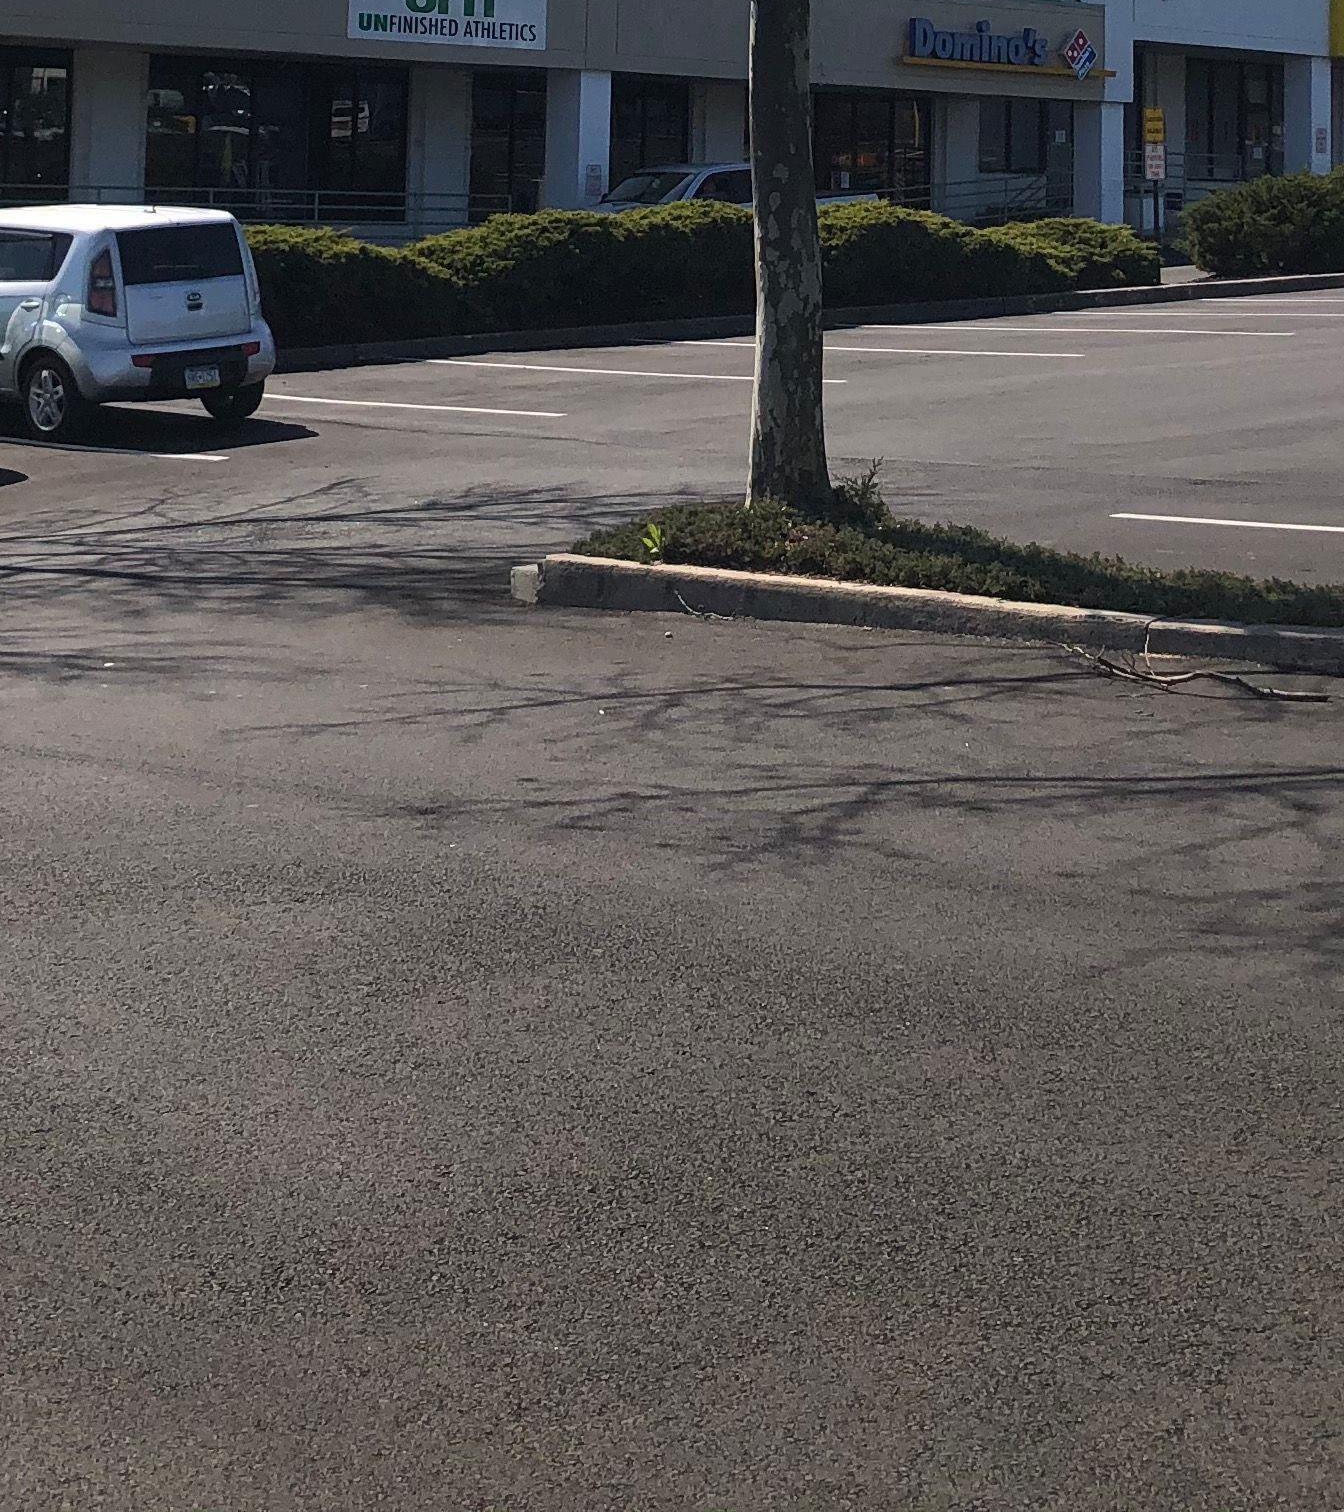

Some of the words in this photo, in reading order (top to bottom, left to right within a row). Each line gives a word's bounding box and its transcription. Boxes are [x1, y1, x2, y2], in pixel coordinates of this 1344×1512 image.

[358, 12, 459, 37] UNFINISHED
[463, 20, 537, 42] ATHLETICS
[909, 17, 1048, 66] Domino's
